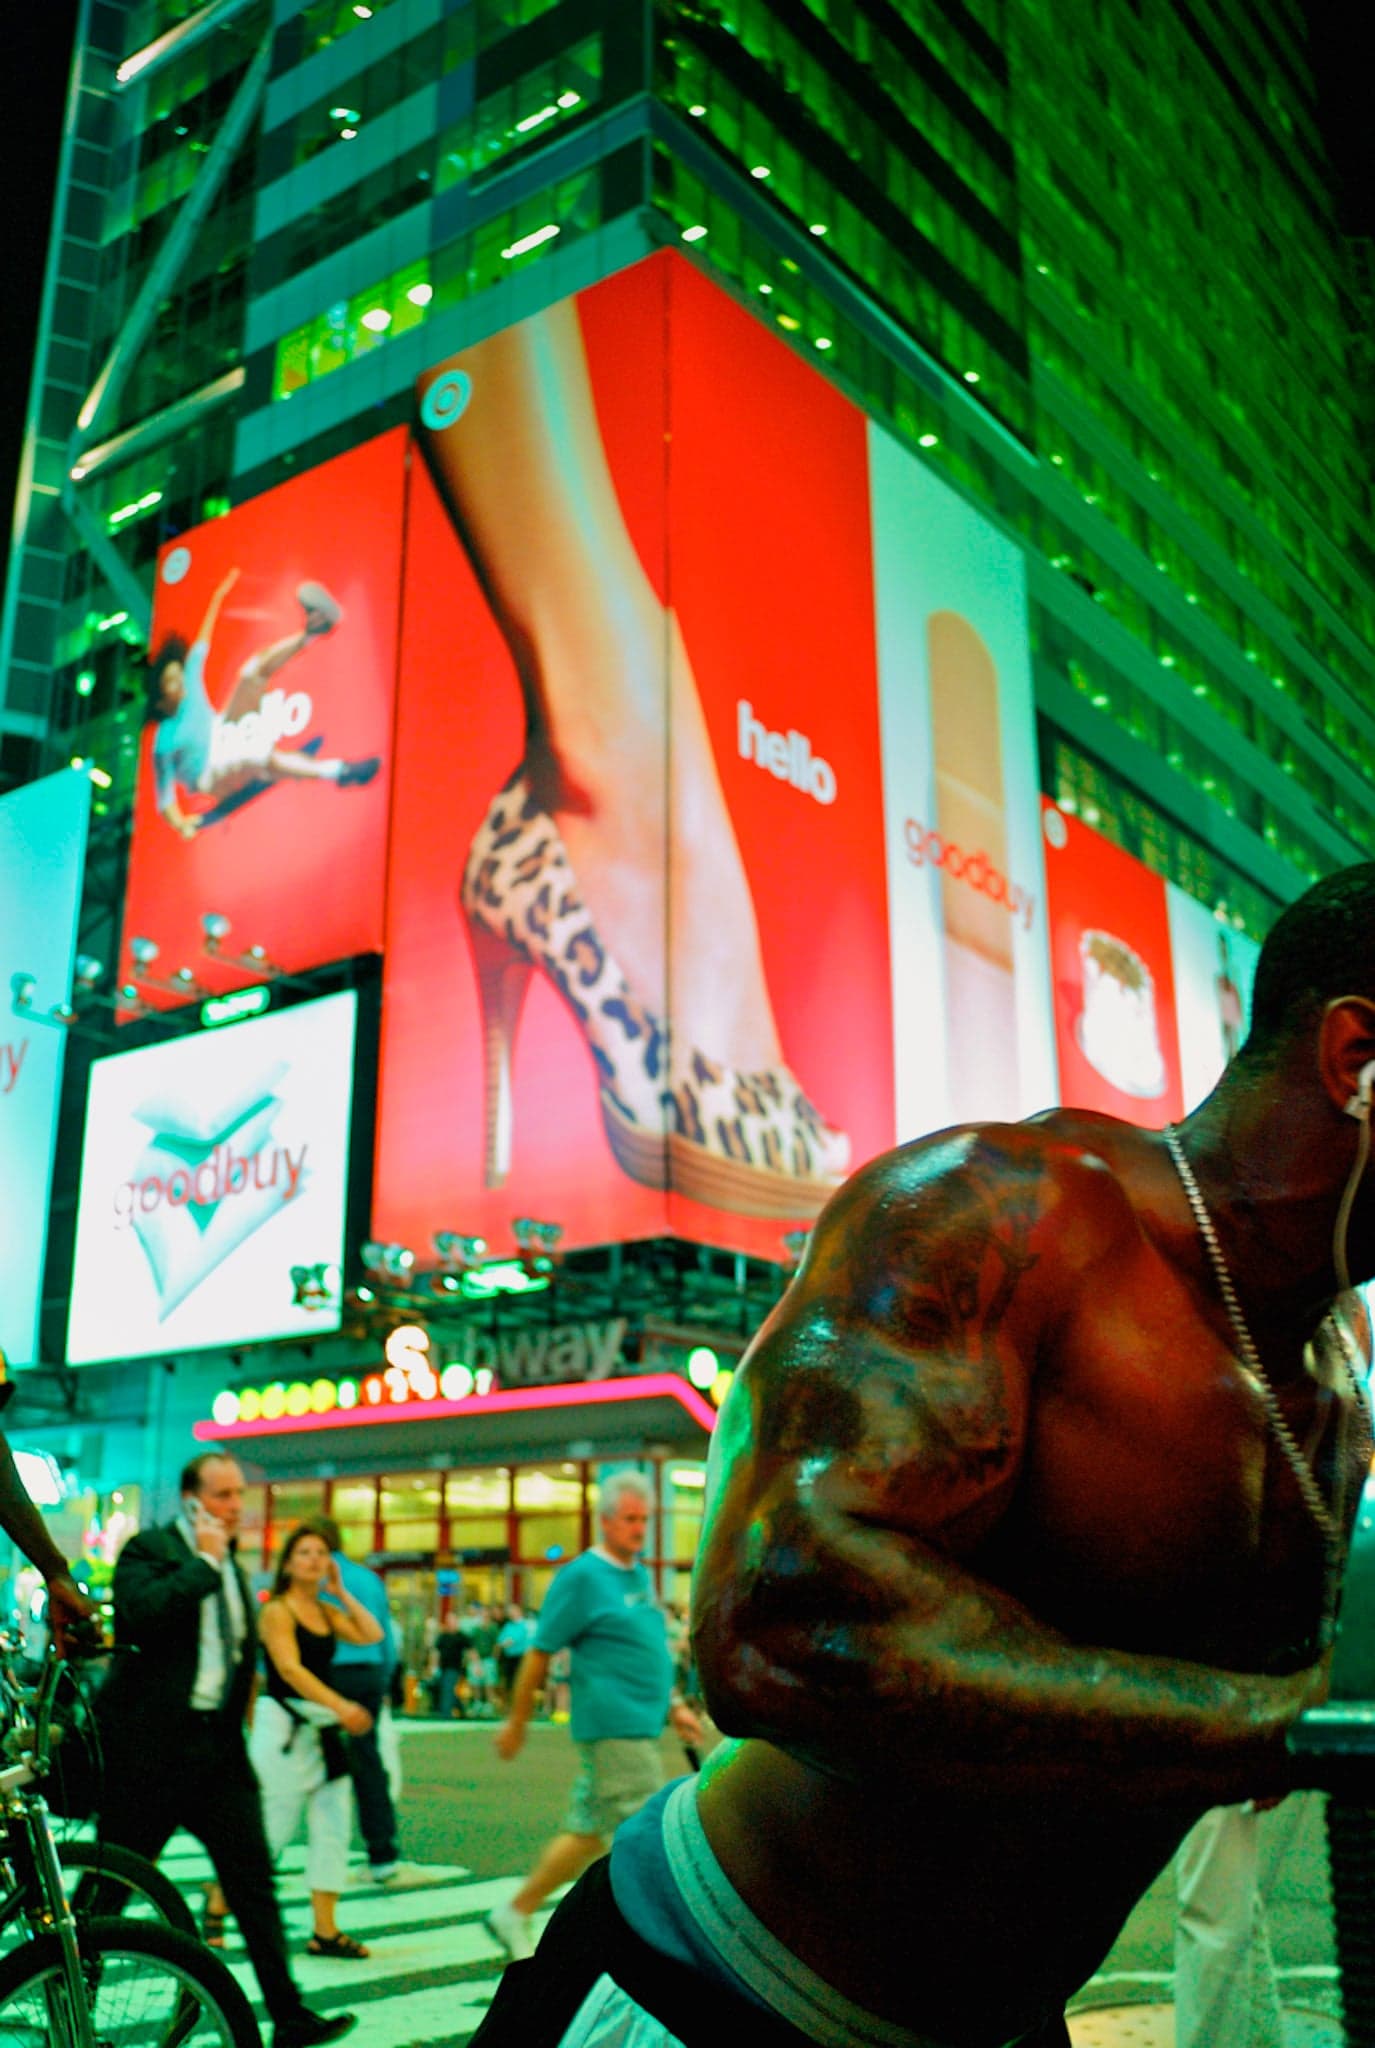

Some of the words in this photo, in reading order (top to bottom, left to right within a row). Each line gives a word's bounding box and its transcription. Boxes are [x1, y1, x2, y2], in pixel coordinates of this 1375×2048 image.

[737, 698, 837, 805] hello
[903, 817, 1034, 932] goodbuy
[113, 1143, 307, 1230] goodbuy
